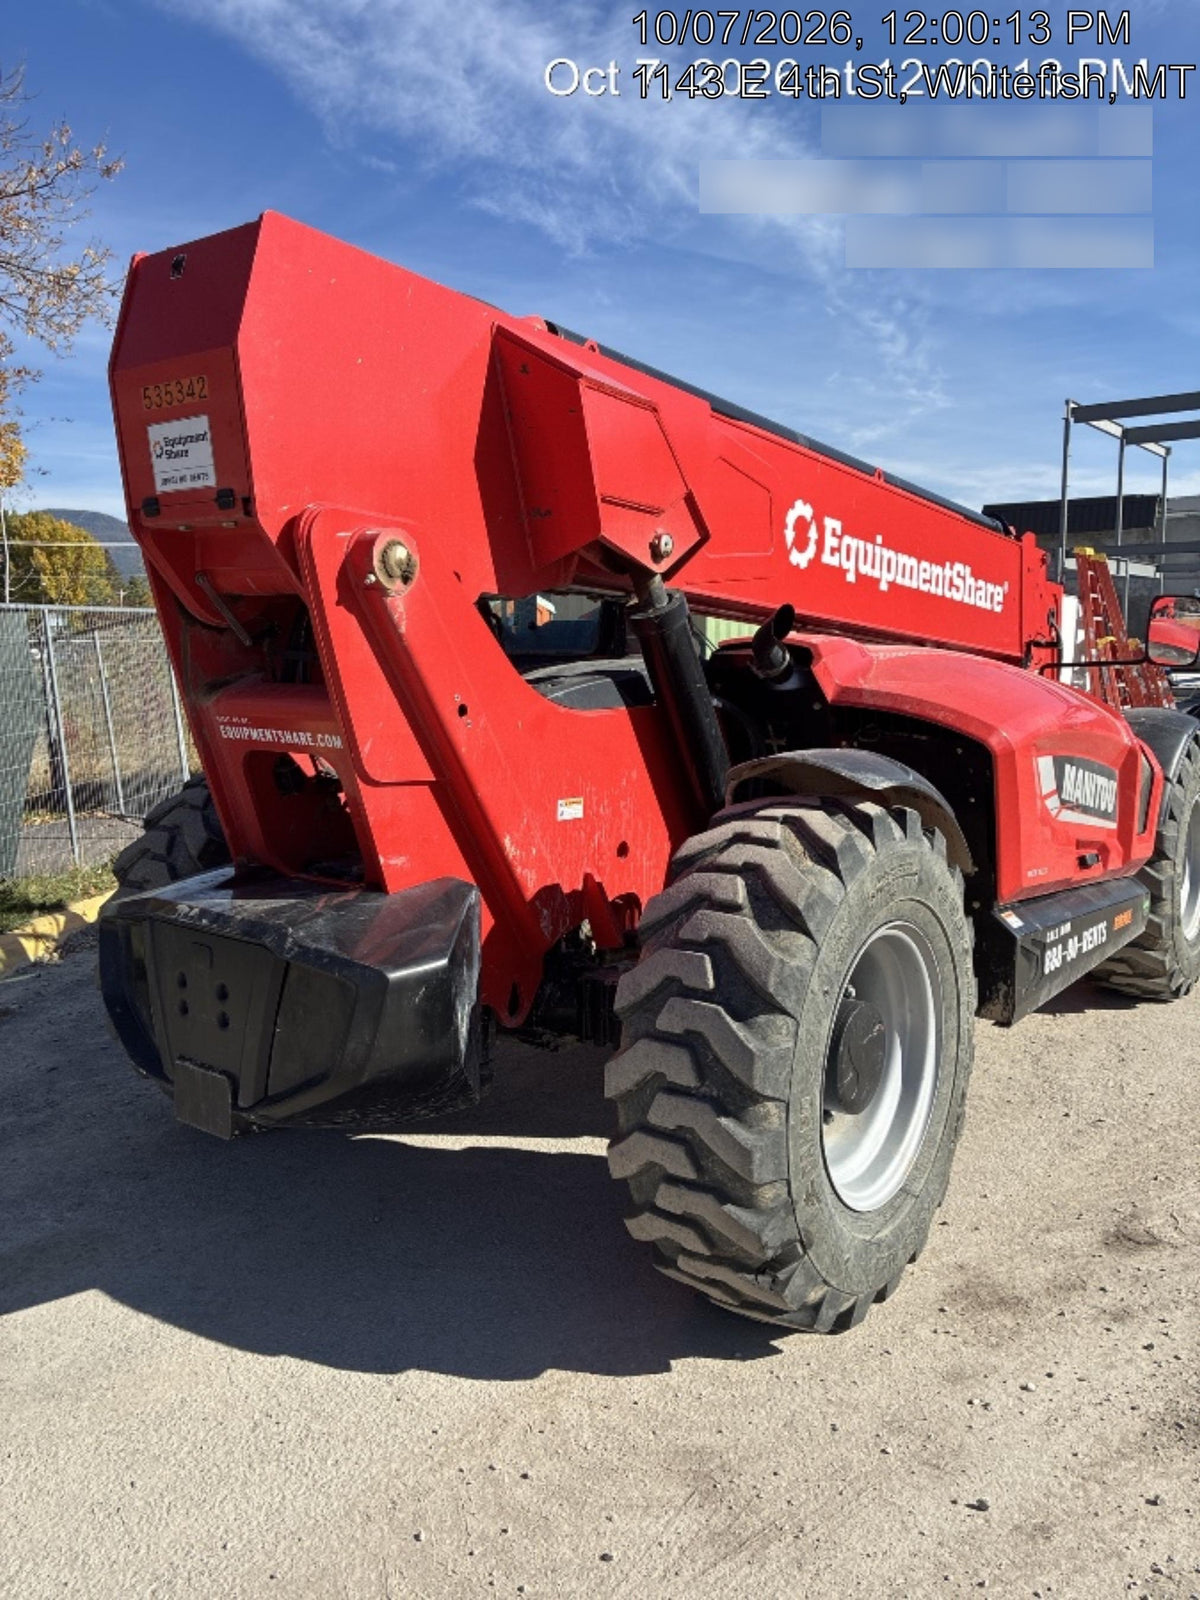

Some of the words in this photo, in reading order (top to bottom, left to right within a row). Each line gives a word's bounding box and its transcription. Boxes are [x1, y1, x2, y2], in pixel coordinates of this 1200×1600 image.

[143, 376, 208, 409] 535342
[821, 515, 1004, 613] EquipmentShare
[219, 724, 343, 749] EQUIPMENTSHARE.COM
[1061, 762, 1117, 813] MANITOU
